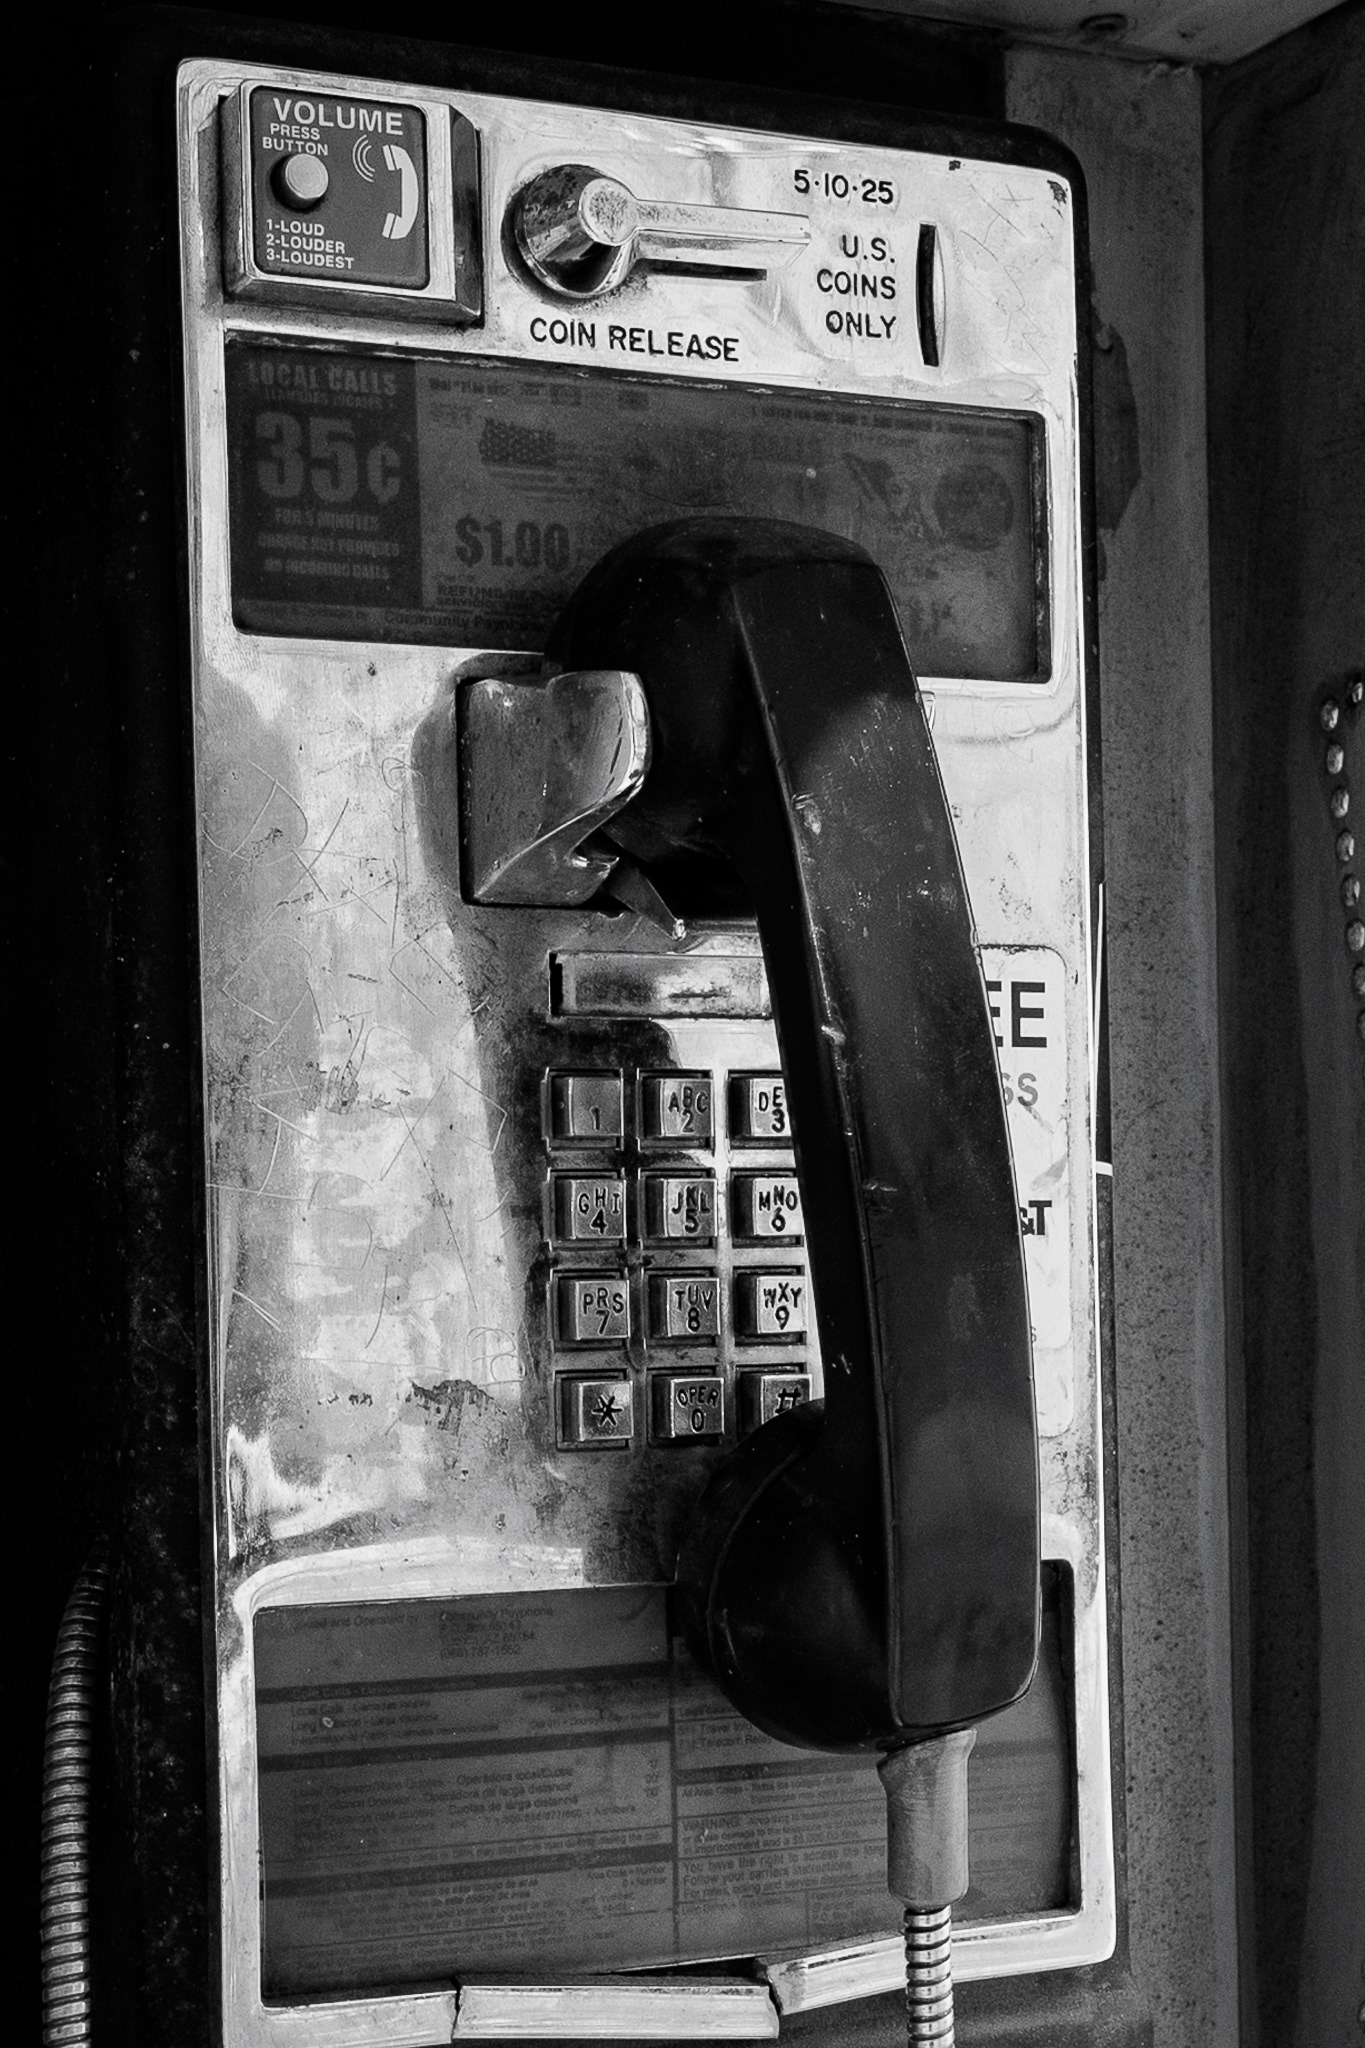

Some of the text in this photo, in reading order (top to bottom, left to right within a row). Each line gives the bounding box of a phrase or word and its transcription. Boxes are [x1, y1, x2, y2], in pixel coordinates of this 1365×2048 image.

[272, 97, 404, 136] VOLUME
[270, 123, 321, 141] PRESS
[262, 136, 328, 156] BUTTON
[267, 219, 325, 236] 1-LOUD
[266, 234, 346, 254] 2-LOUDER
[841, 233, 896, 264] U.S.
[267, 249, 355, 269] 3-LOUDEST
[816, 268, 897, 300] COINS
[825, 310, 898, 339] ONLY
[530, 317, 740, 362] COIN RELEASE
[327, 364, 397, 396] CALLS
[255, 411, 402, 504] 35¢
[455, 513, 571, 573] $1.00
[667, 1086, 709, 1113] ABC
[589, 1106, 601, 1131] 1
[681, 1110, 695, 1133] 2
[770, 1108, 786, 1133] 3
[578, 1186, 621, 1215] GHI
[670, 1185, 711, 1214] JKL
[758, 1184, 798, 1212] MNO
[590, 1208, 607, 1234] 4
[683, 1207, 700, 1233] 5
[770, 1206, 787, 1233] 6
[583, 1287, 625, 1315] PRS
[674, 1284, 714, 1311] TUV
[763, 1282, 803, 1309] WXY
[595, 1309, 610, 1335] 7
[687, 1306, 701, 1333] 8
[774, 1306, 790, 1332] 9
[677, 1387, 719, 1408] OPER
[691, 1408, 706, 1433] 0
